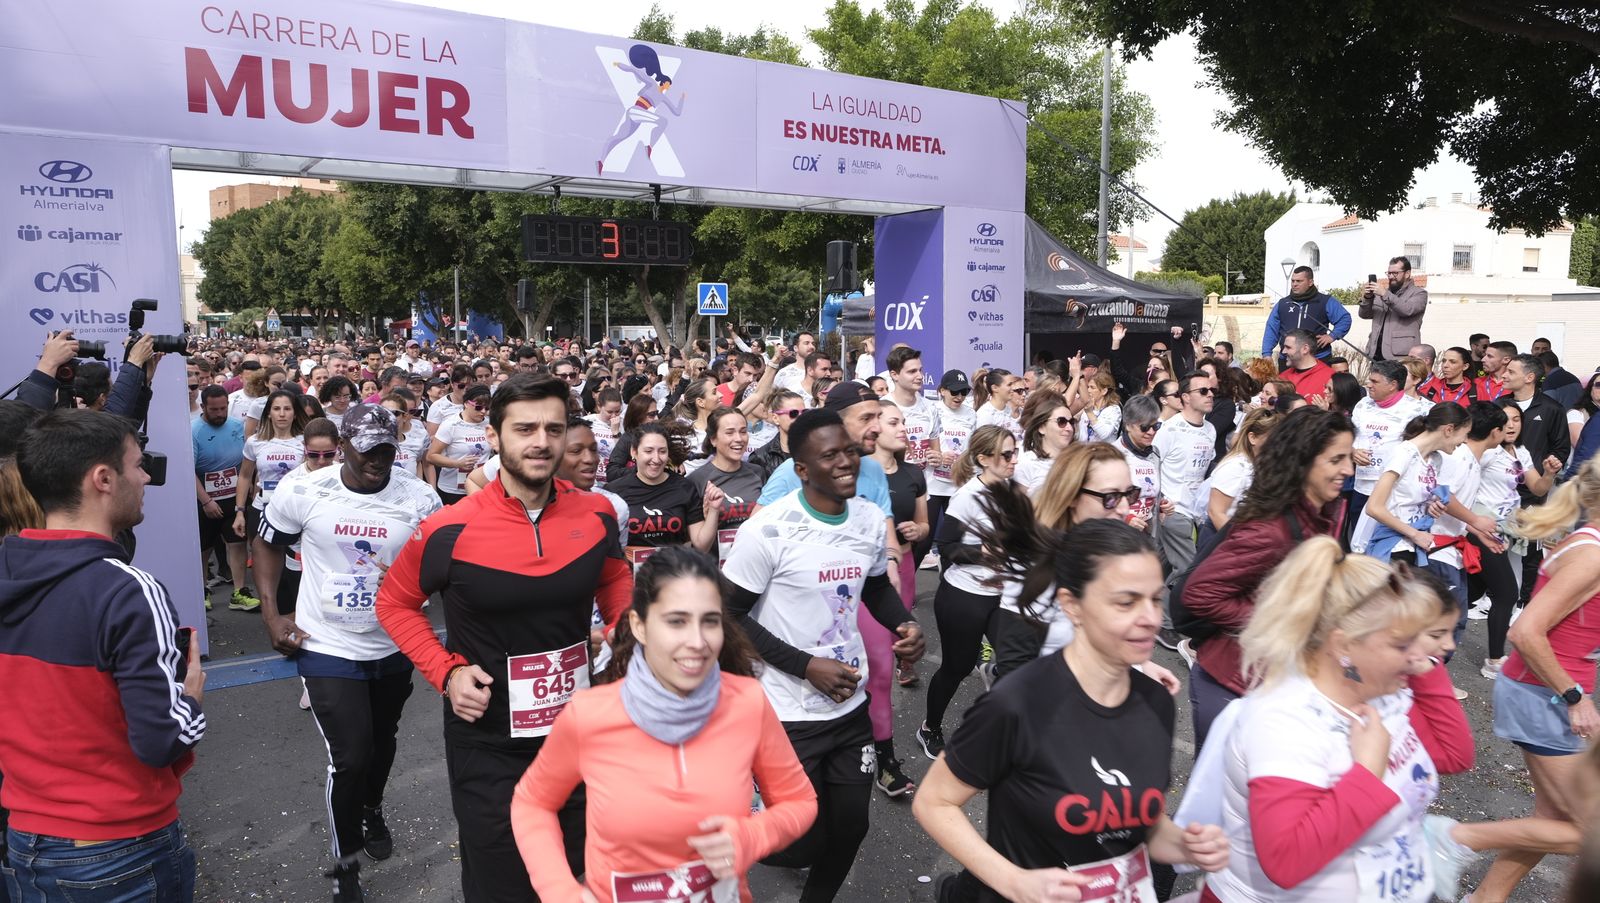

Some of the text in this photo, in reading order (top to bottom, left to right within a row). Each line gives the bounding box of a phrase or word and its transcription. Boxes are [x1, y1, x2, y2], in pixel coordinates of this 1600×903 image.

[201, 6, 457, 65] CARRERA DE LA
[185, 47, 474, 139] MUJER
[812, 92, 922, 124] LA IGUALDAD
[783, 119, 946, 155] ES NUESTRA META.
[793, 155, 821, 172] CDX
[851, 159, 882, 170] ALMERÍA
[20, 185, 114, 200] HYUNDAI
[33, 200, 104, 212] Almerialva
[47, 227, 122, 243] cajamar
[601, 223, 620, 258] 3
[969, 238, 1004, 246] HYUNDAI
[978, 262, 1006, 273] cajamar
[34, 271, 100, 293] CASI
[971, 287, 996, 302] CASI
[60, 309, 127, 324] vithas
[884, 296, 929, 331] CDX
[979, 311, 1004, 321] vithas
[79, 327, 96, 335] para
[97, 326, 128, 334] cuidarte
[973, 341, 1003, 352] aqualia
[906, 426, 924, 435] UJER
[1366, 424, 1389, 432] MUJER
[213, 478, 232, 488] 643
[334, 524, 388, 538] MUJER
[628, 516, 682, 533] GALO
[819, 567, 862, 583] MUJER
[333, 592, 377, 608] 135
[533, 671, 575, 699] 645
[532, 698, 551, 706] JUAN
[1055, 787, 1166, 835] GALO
